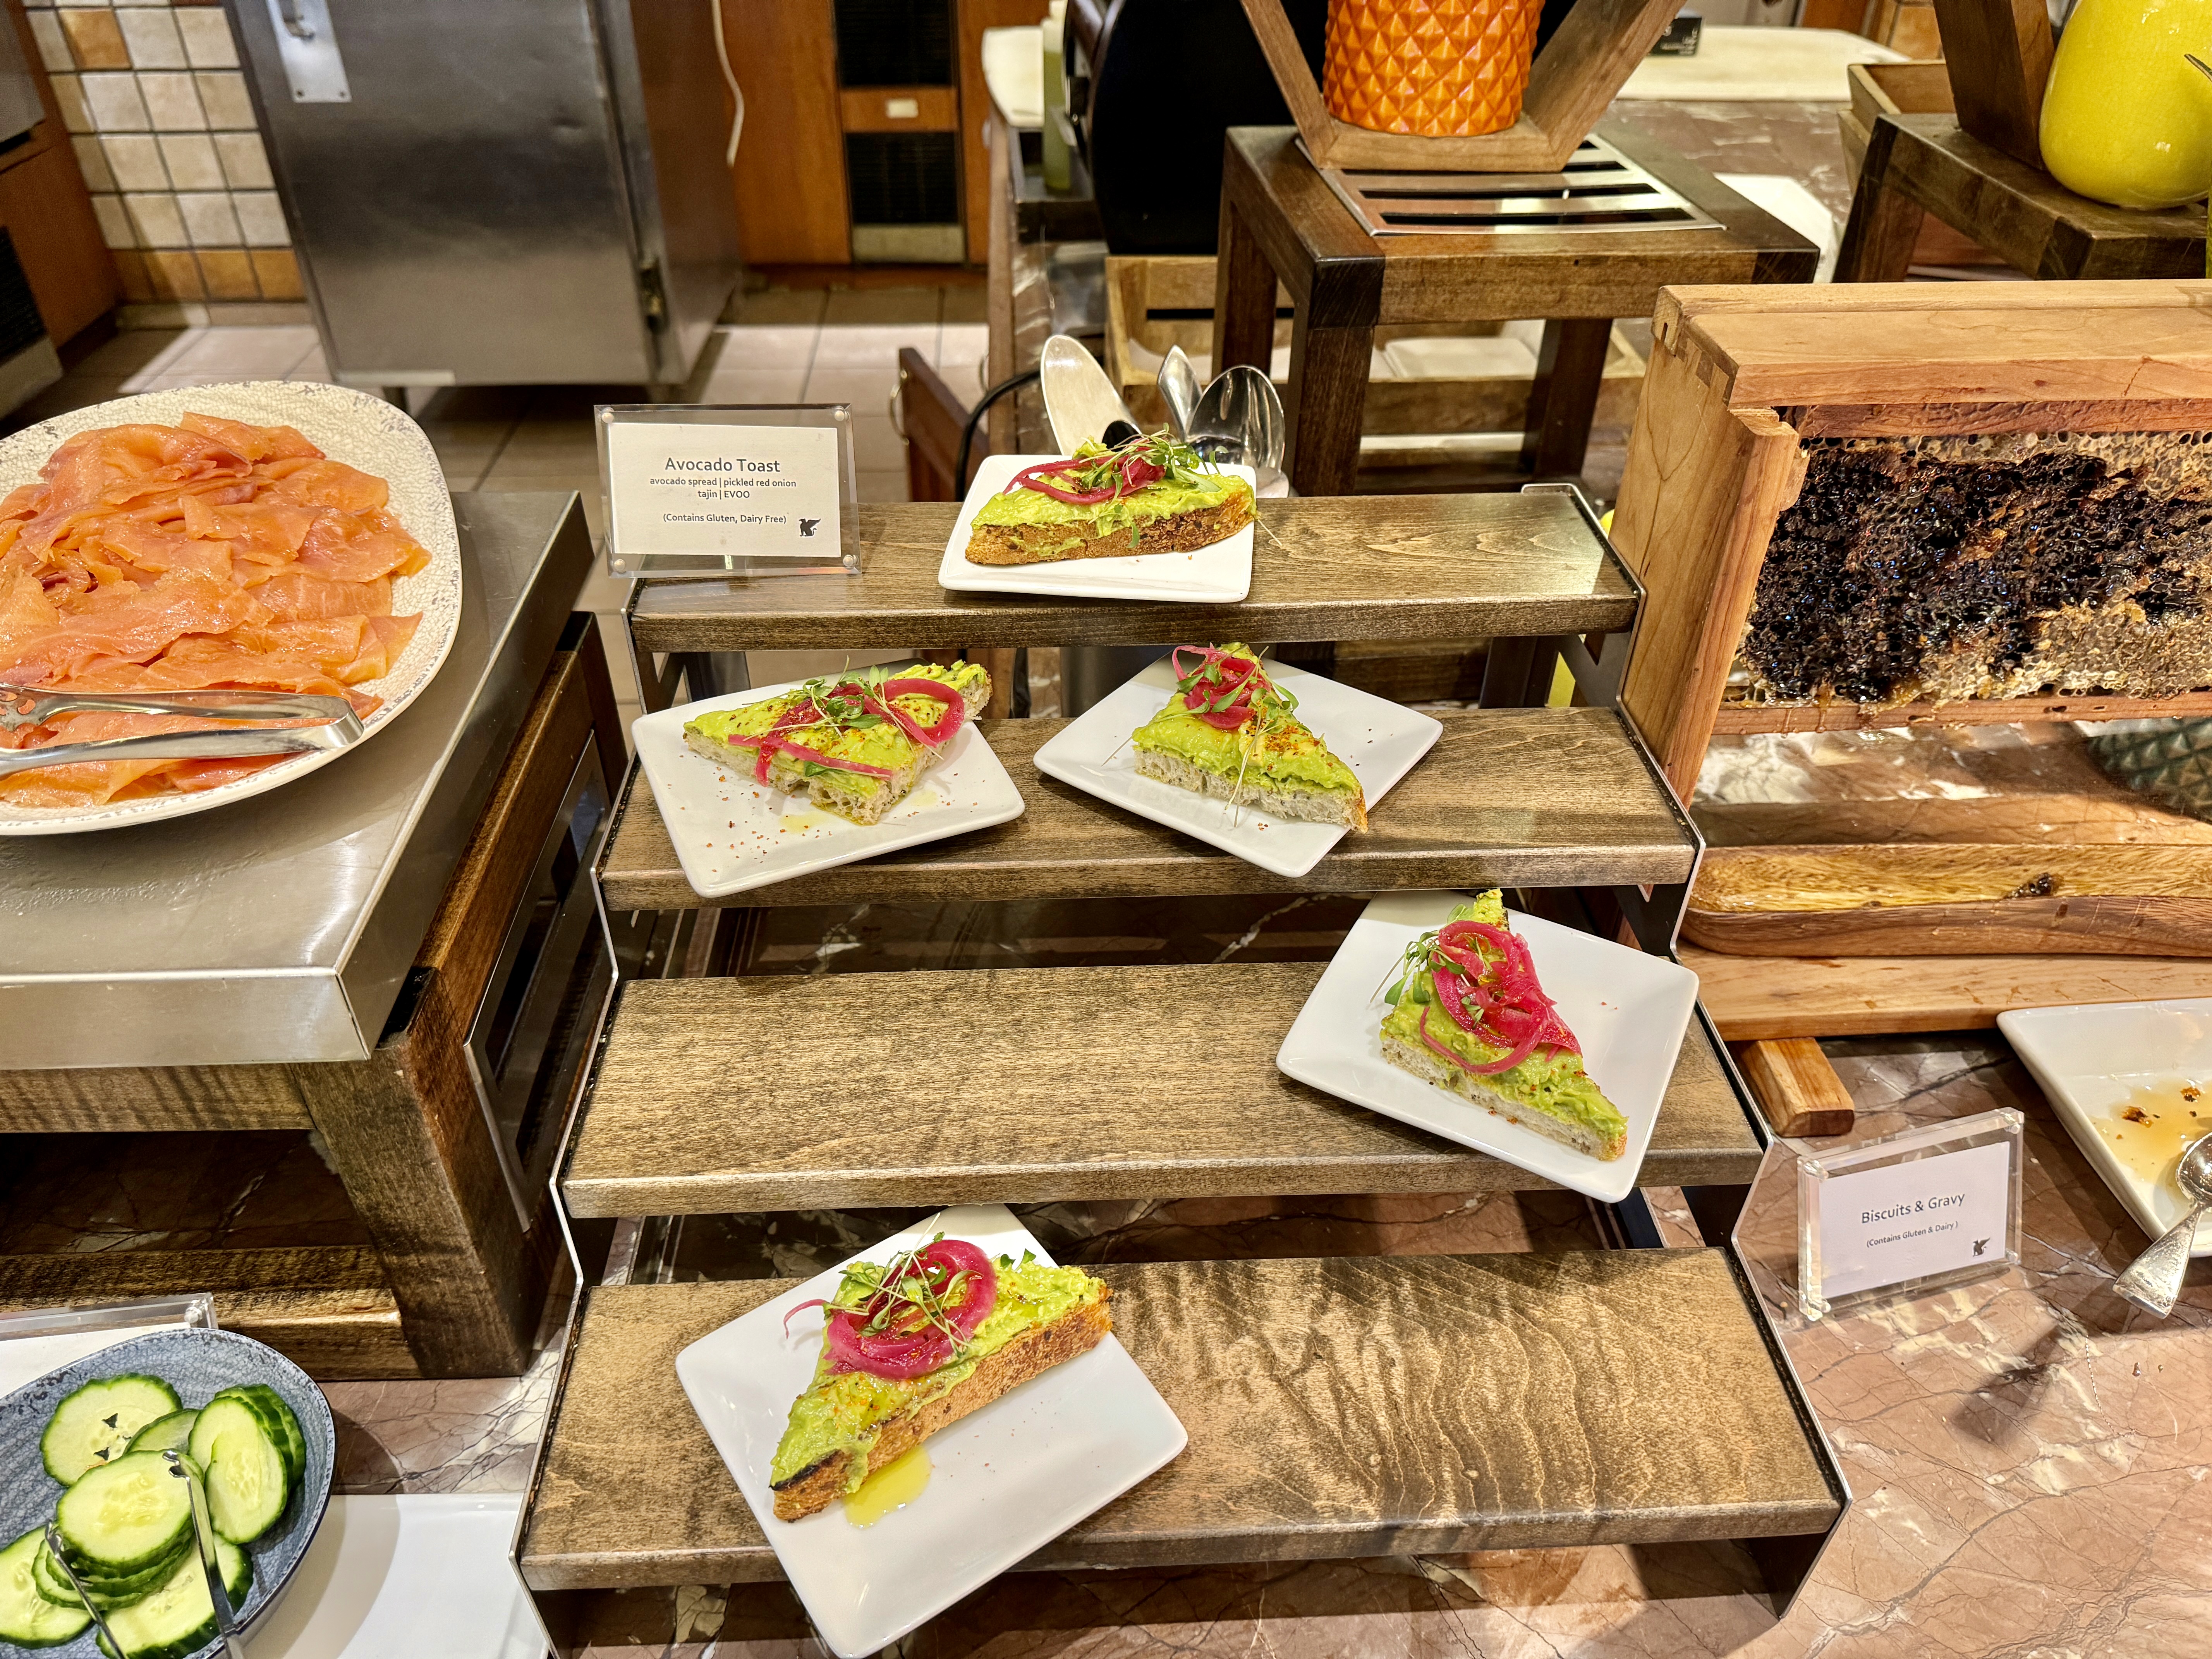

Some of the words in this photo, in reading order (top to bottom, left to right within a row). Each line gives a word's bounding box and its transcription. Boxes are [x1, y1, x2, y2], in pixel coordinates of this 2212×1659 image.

[665, 457, 732, 471] Avocado
[736, 459, 780, 472] Toast
[688, 477, 717, 487] spread
[724, 477, 754, 488] pickled
[698, 489, 717, 500] tajin
[663, 514, 704, 522] (Contains
[706, 514, 737, 524] Gluten,
[740, 515, 763, 524] Dairy
[765, 515, 787, 524] Free)
[1862, 1204, 1911, 1223] Biscuits
[1915, 1200, 1923, 1212] &
[1928, 1194, 1965, 1209] Gravy
[1867, 1234, 1901, 1248] (Contains
[1903, 1229, 1926, 1238] Gluten
[1935, 1222, 1954, 1231] Dairy
